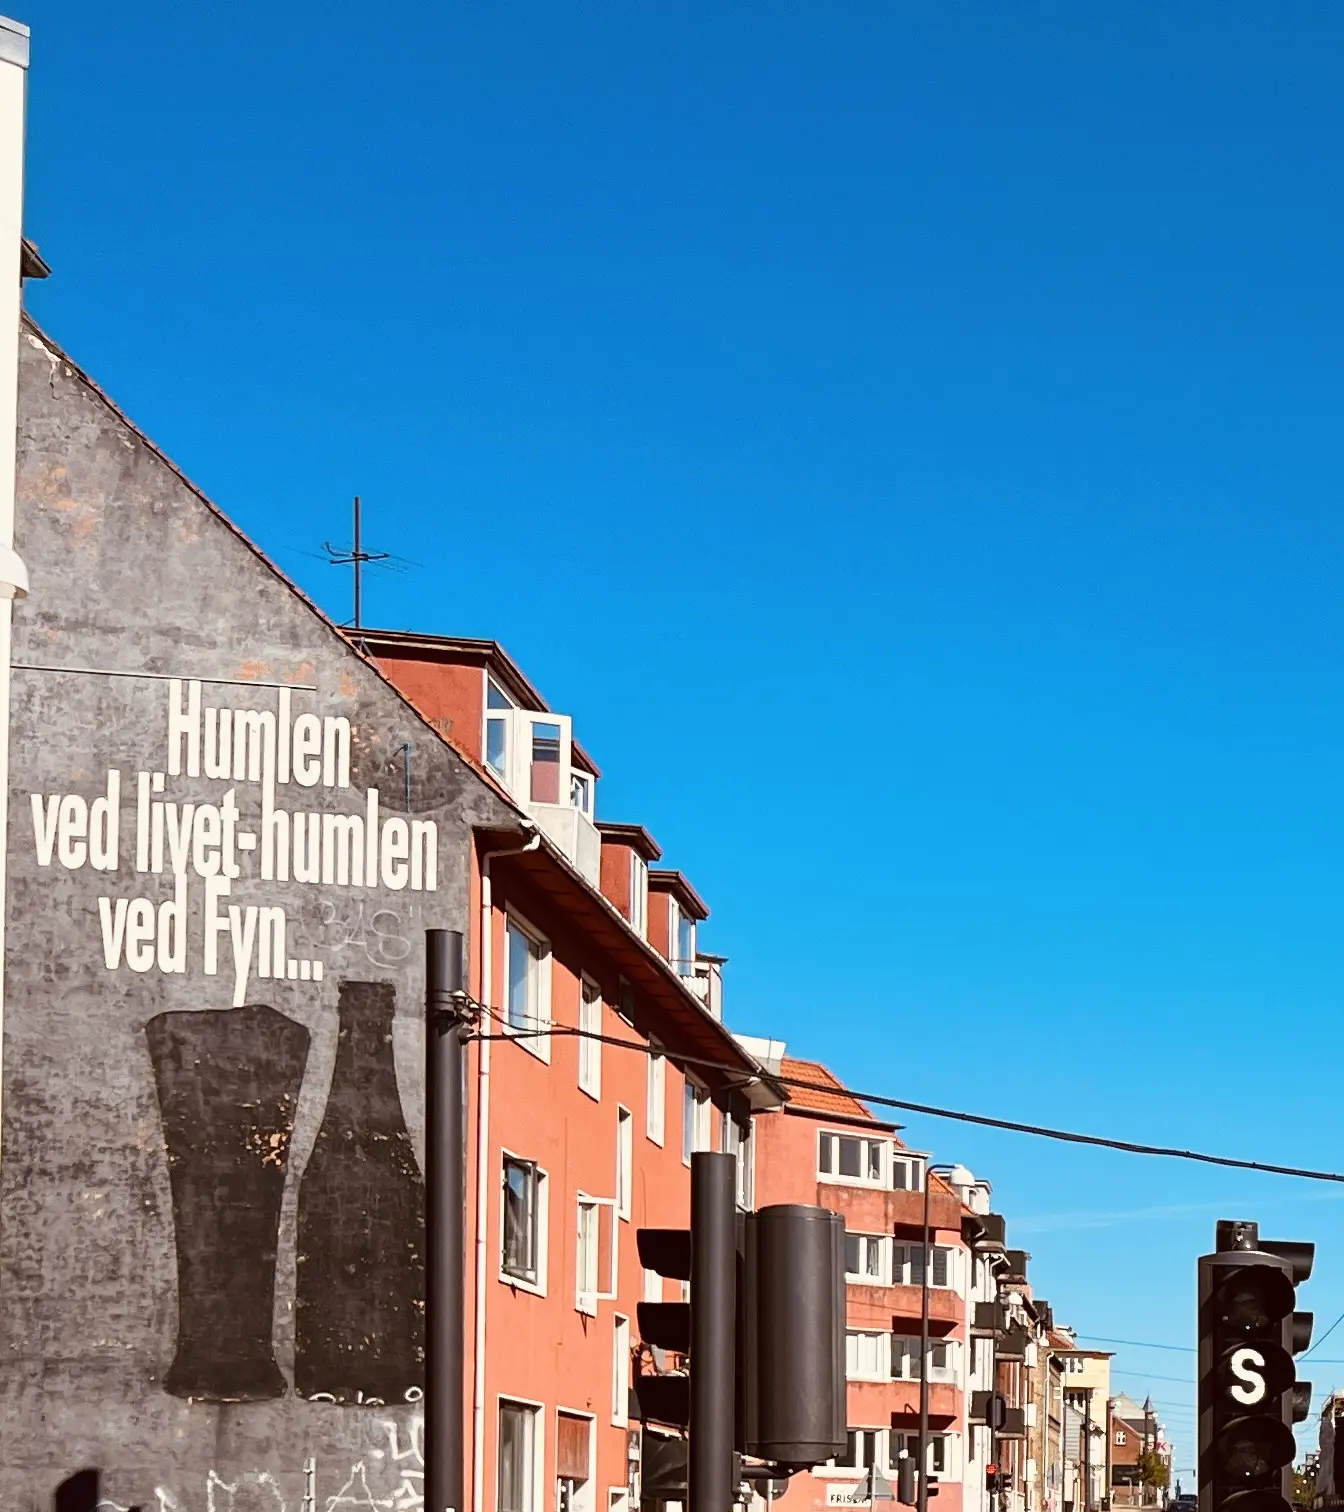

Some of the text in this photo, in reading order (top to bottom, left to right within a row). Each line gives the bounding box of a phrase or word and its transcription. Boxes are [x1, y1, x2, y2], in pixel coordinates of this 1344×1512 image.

[168, 679, 351, 788] Humlen
[30, 769, 437, 891] ved livet-humlen
[98, 875, 187, 974] ved
[204, 876, 324, 1008] Fyn...
[1231, 1348, 1265, 1404] S
